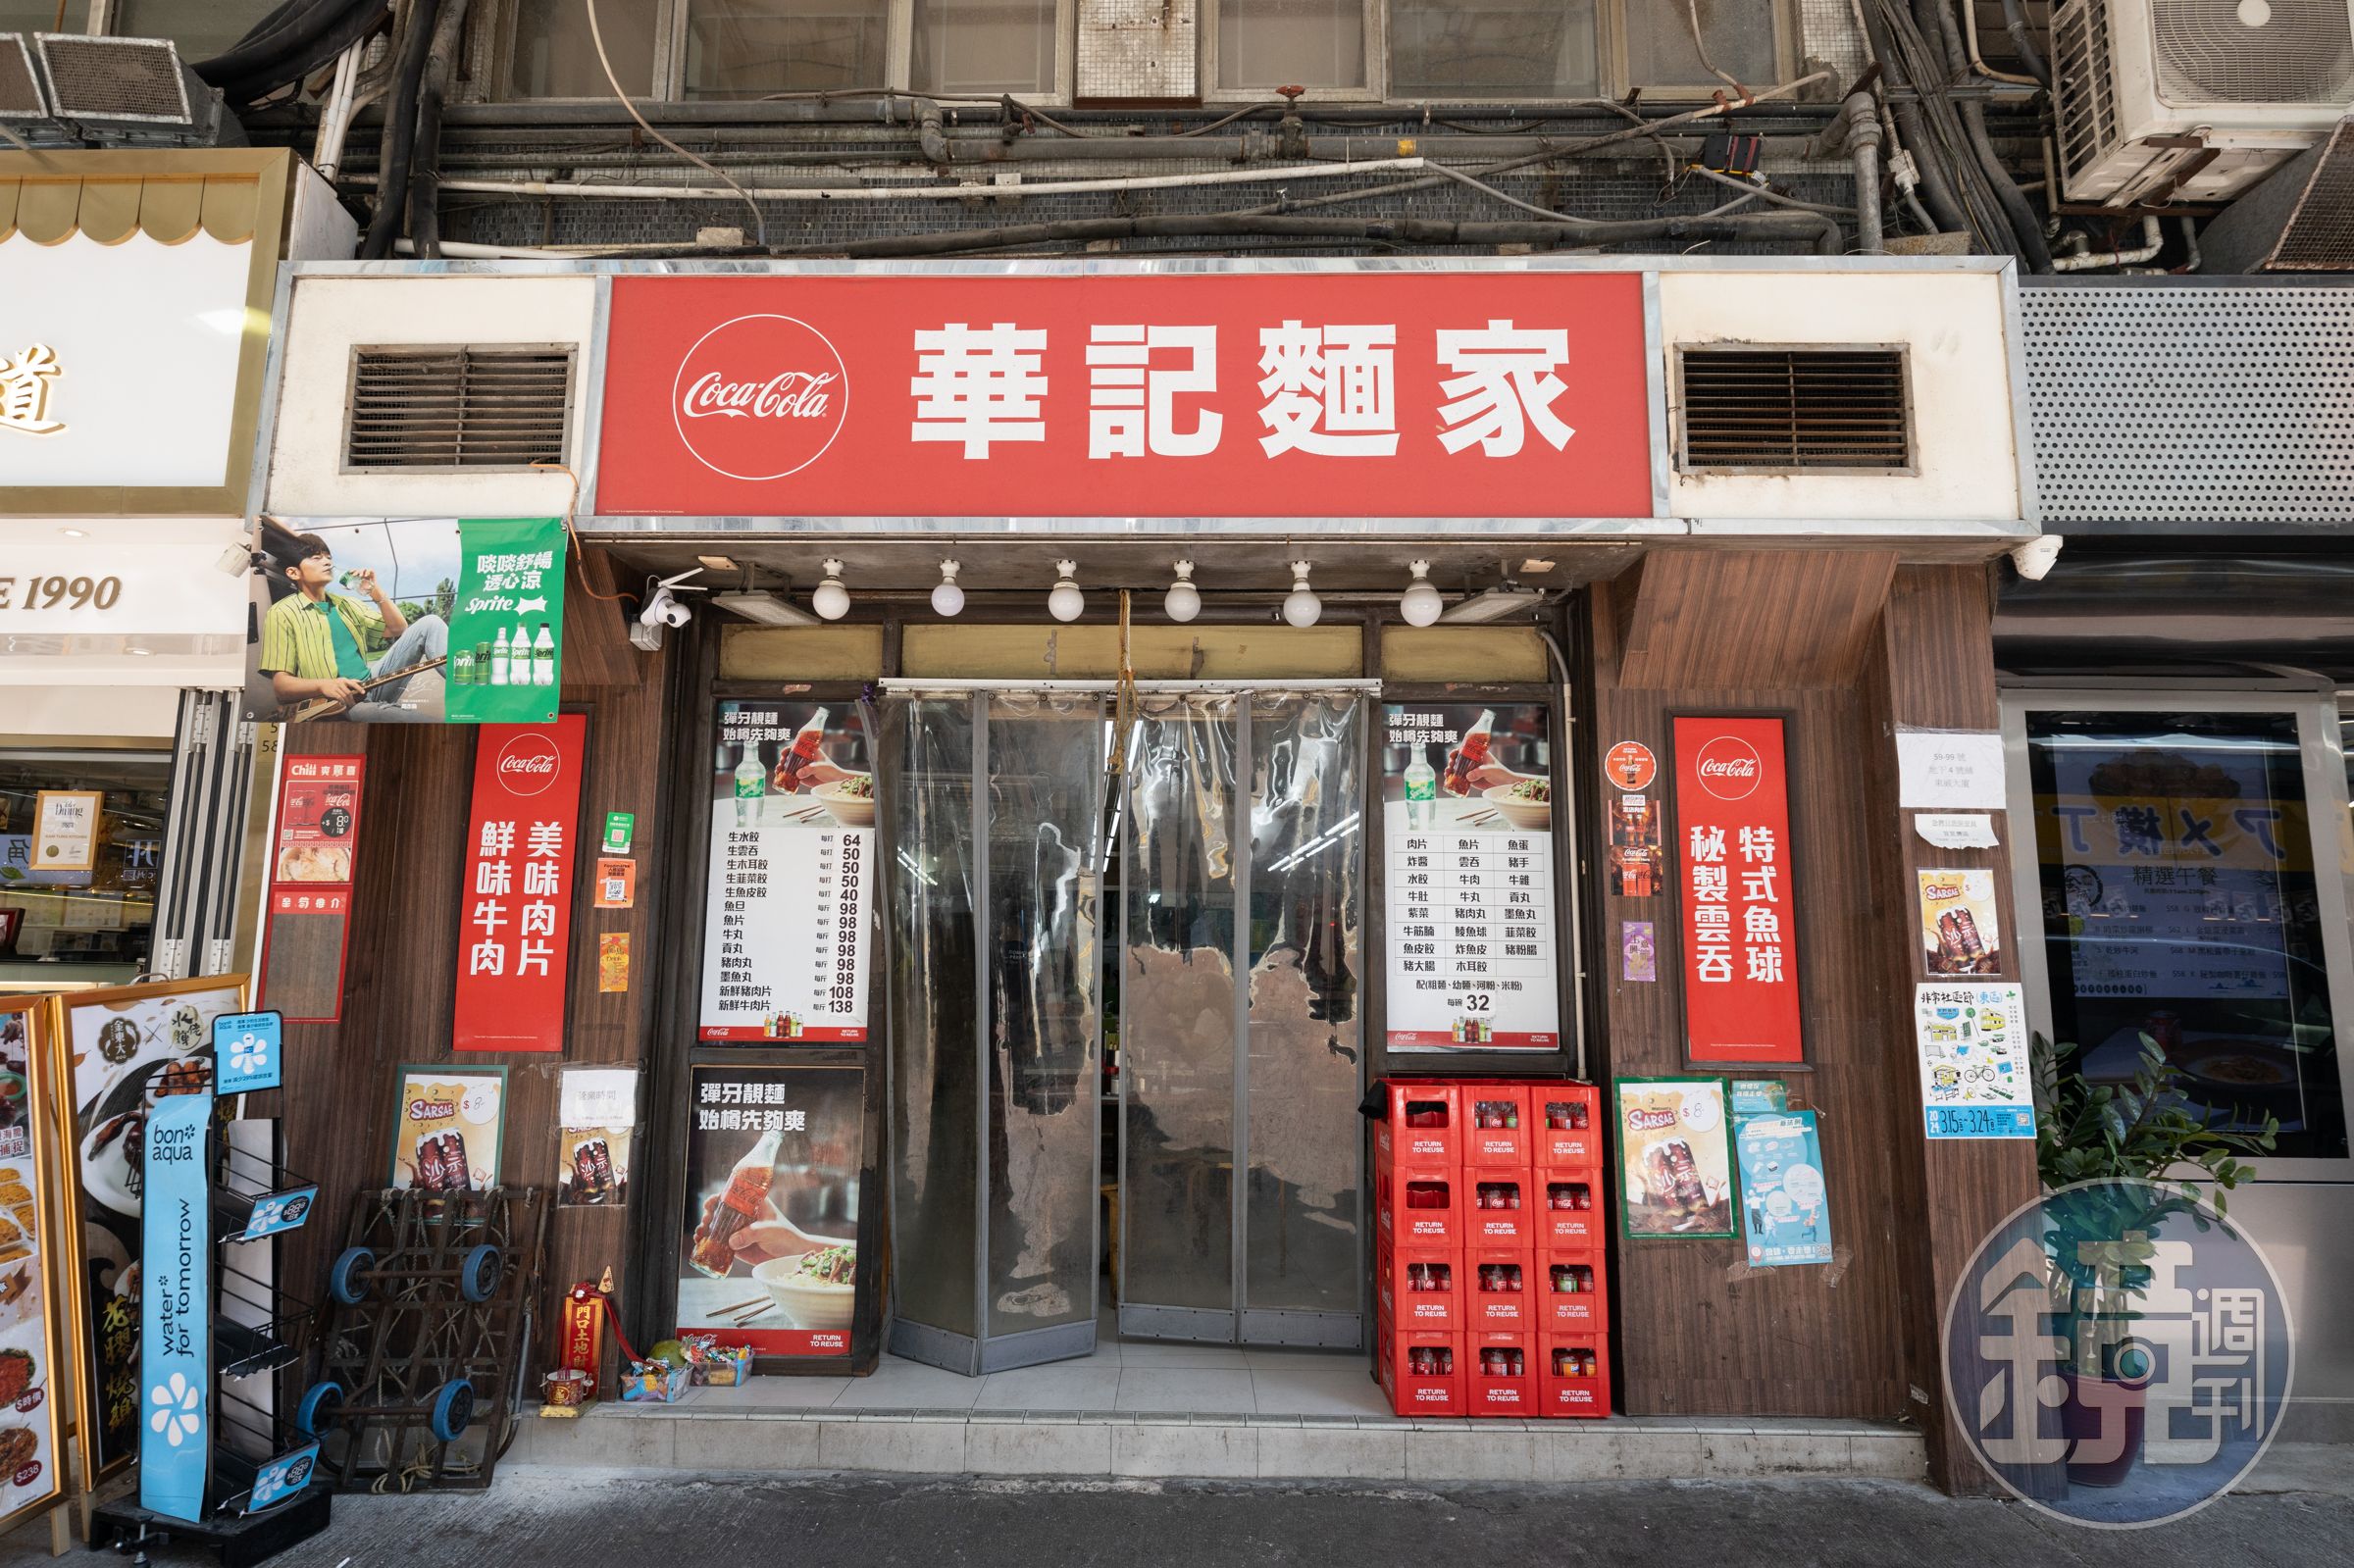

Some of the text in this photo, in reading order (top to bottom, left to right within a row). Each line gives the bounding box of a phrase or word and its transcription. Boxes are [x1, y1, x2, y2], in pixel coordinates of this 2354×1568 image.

[0, 343, 66, 433] 道
[910, 319, 1576, 460] 華記麵家
[683, 370, 840, 421] Coca-Cola
[477, 551, 553, 574] 啖啖舒暢
[484, 571, 542, 591] 透心涼
[22, 576, 122, 610] 1990
[465, 595, 514, 614] Sprite
[724, 712, 778, 725] 彈牙靚麵
[1389, 714, 1444, 727] 彈牙靚麵
[291, 763, 317, 776] Chill
[501, 755, 557, 773] Coca-Cola
[1701, 758, 1758, 777] Coca-Cola
[729, 832, 759, 842] 生水餃
[844, 835, 860, 846] 64
[1407, 839, 1427, 849] 肉片
[1458, 839, 1479, 850] 魚片
[1509, 840, 1529, 850] 魚蛋
[728, 845, 758, 856] 生雲吞
[843, 848, 860, 860] 50
[727, 859, 768, 870] 生木耳餃
[842, 862, 859, 874] 50
[1407, 856, 1428, 867] 炸醬
[1459, 857, 1479, 867] 雲吞
[1509, 857, 1529, 868] 豬手
[842, 876, 858, 887] 50
[1407, 874, 1428, 885] 水餃
[1459, 875, 1480, 885] 牛肉
[2132, 866, 2218, 886] 精選午餐
[470, 821, 516, 976] 鮮味牛肉
[517, 821, 563, 976] 美味肉片
[726, 887, 766, 897] 生魚皮餃
[841, 889, 857, 901] 40
[1408, 891, 1428, 902] 牛肚
[1460, 891, 1480, 902] 牛丸
[1510, 892, 1530, 903] 貢丸
[1925, 885, 1960, 901] SARSAE
[725, 901, 744, 911] 魚旦
[841, 903, 857, 915] 98
[1690, 826, 1734, 983] 秘製雲吞
[1739, 826, 1783, 983] 特式魚球
[1408, 908, 1428, 919] 紫菜
[1456, 908, 1486, 919] 豬肉丸
[1505, 909, 1536, 920] 墨魚丸
[724, 915, 744, 926] 魚片
[840, 917, 856, 929] 98
[723, 930, 743, 940] 牛丸
[839, 932, 856, 942] 98
[1404, 927, 1434, 936] 牛筋腩
[722, 943, 742, 954] 貢丸
[838, 945, 855, 956] 98
[1404, 943, 1434, 954] 魚皮餃
[1456, 944, 1487, 955] 炸魚皮
[721, 957, 752, 968] 豬肉丸
[838, 959, 854, 971] 98
[1457, 962, 1487, 972] 木耳餃
[721, 972, 751, 983] 墨魚丸
[837, 973, 854, 985] 98
[720, 986, 772, 996] 新鮮豬肉片
[829, 986, 853, 998] 108
[1921, 990, 1973, 1005] 非常社區節
[719, 1000, 771, 1011] 新鮮牛肉片
[828, 1001, 852, 1013] 138
[1466, 994, 1490, 1011] 32
[700, 1083, 785, 1104] 彈牙靚麵
[410, 1098, 455, 1121] SARSAE
[1929, 1110, 1938, 1121] 20
[698, 1110, 805, 1131] 始樽先夠爽
[1628, 1109, 1676, 1131] SARSAE
[1929, 1122, 1940, 1134] 24
[152, 1144, 193, 1165] aqua
[177, 1198, 194, 1357] for tomorrow
[16, 1464, 39, 1483] $238
